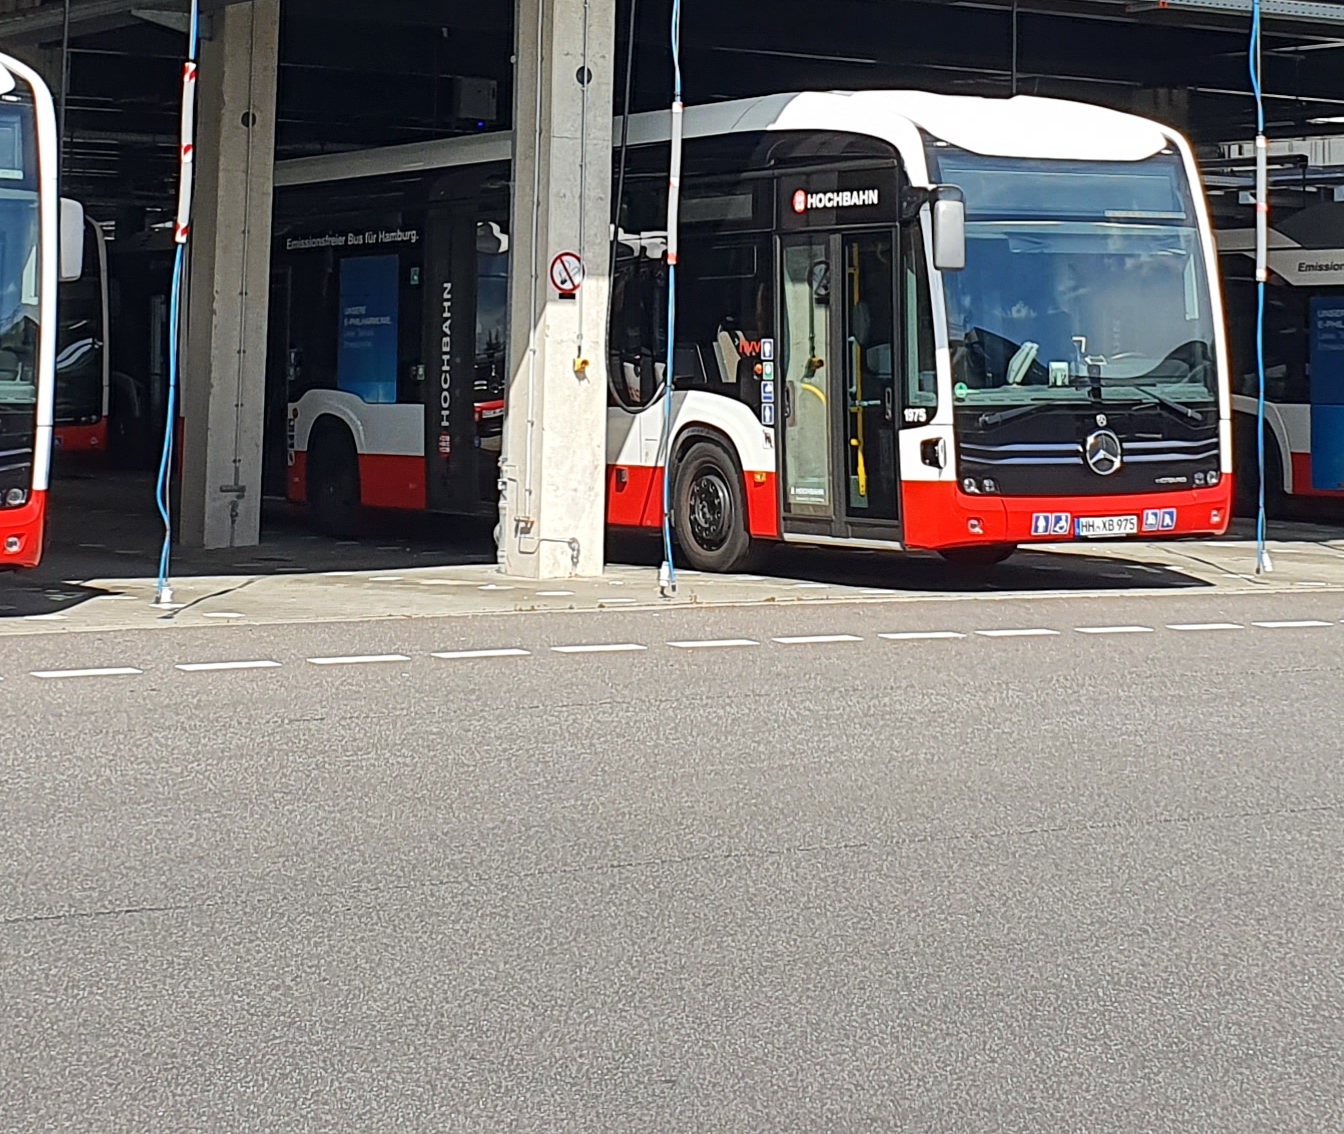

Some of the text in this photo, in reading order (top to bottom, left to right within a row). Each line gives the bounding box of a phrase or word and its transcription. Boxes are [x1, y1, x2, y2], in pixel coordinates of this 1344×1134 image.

[807, 189, 878, 209] HOCHBAHN
[347, 232, 363, 245] Bus
[365, 231, 377, 244] für
[378, 228, 419, 243] Hamburg.
[440, 282, 452, 427] HOCHBAHN
[904, 408, 927, 422] 1975
[1080, 517, 1135, 533] HH XB 975
